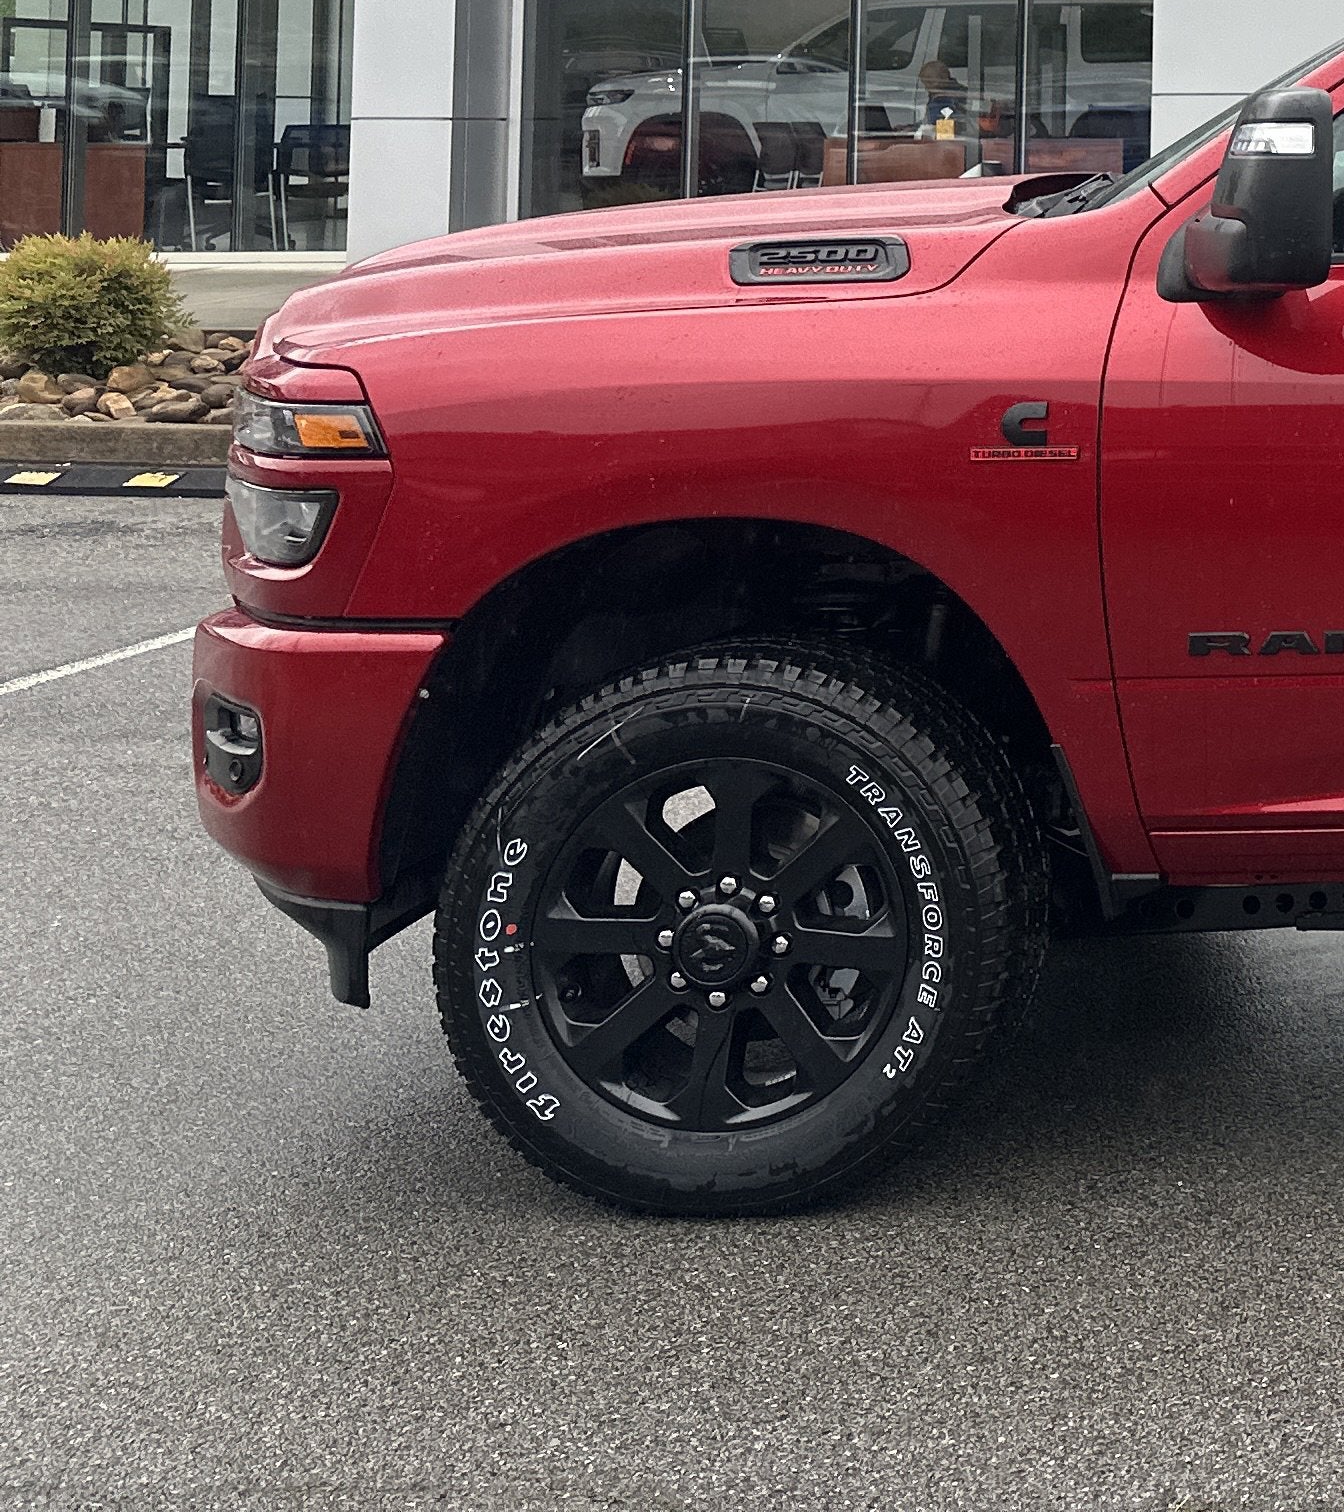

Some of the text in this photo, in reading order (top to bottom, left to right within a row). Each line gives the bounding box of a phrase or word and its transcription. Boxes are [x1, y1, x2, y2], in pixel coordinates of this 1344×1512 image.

[759, 246, 879, 266] 2500
[759, 264, 878, 275] HEAVY DUTY
[846, 764, 944, 1008] TRANSFORCE
[475, 838, 560, 1121] Firestone
